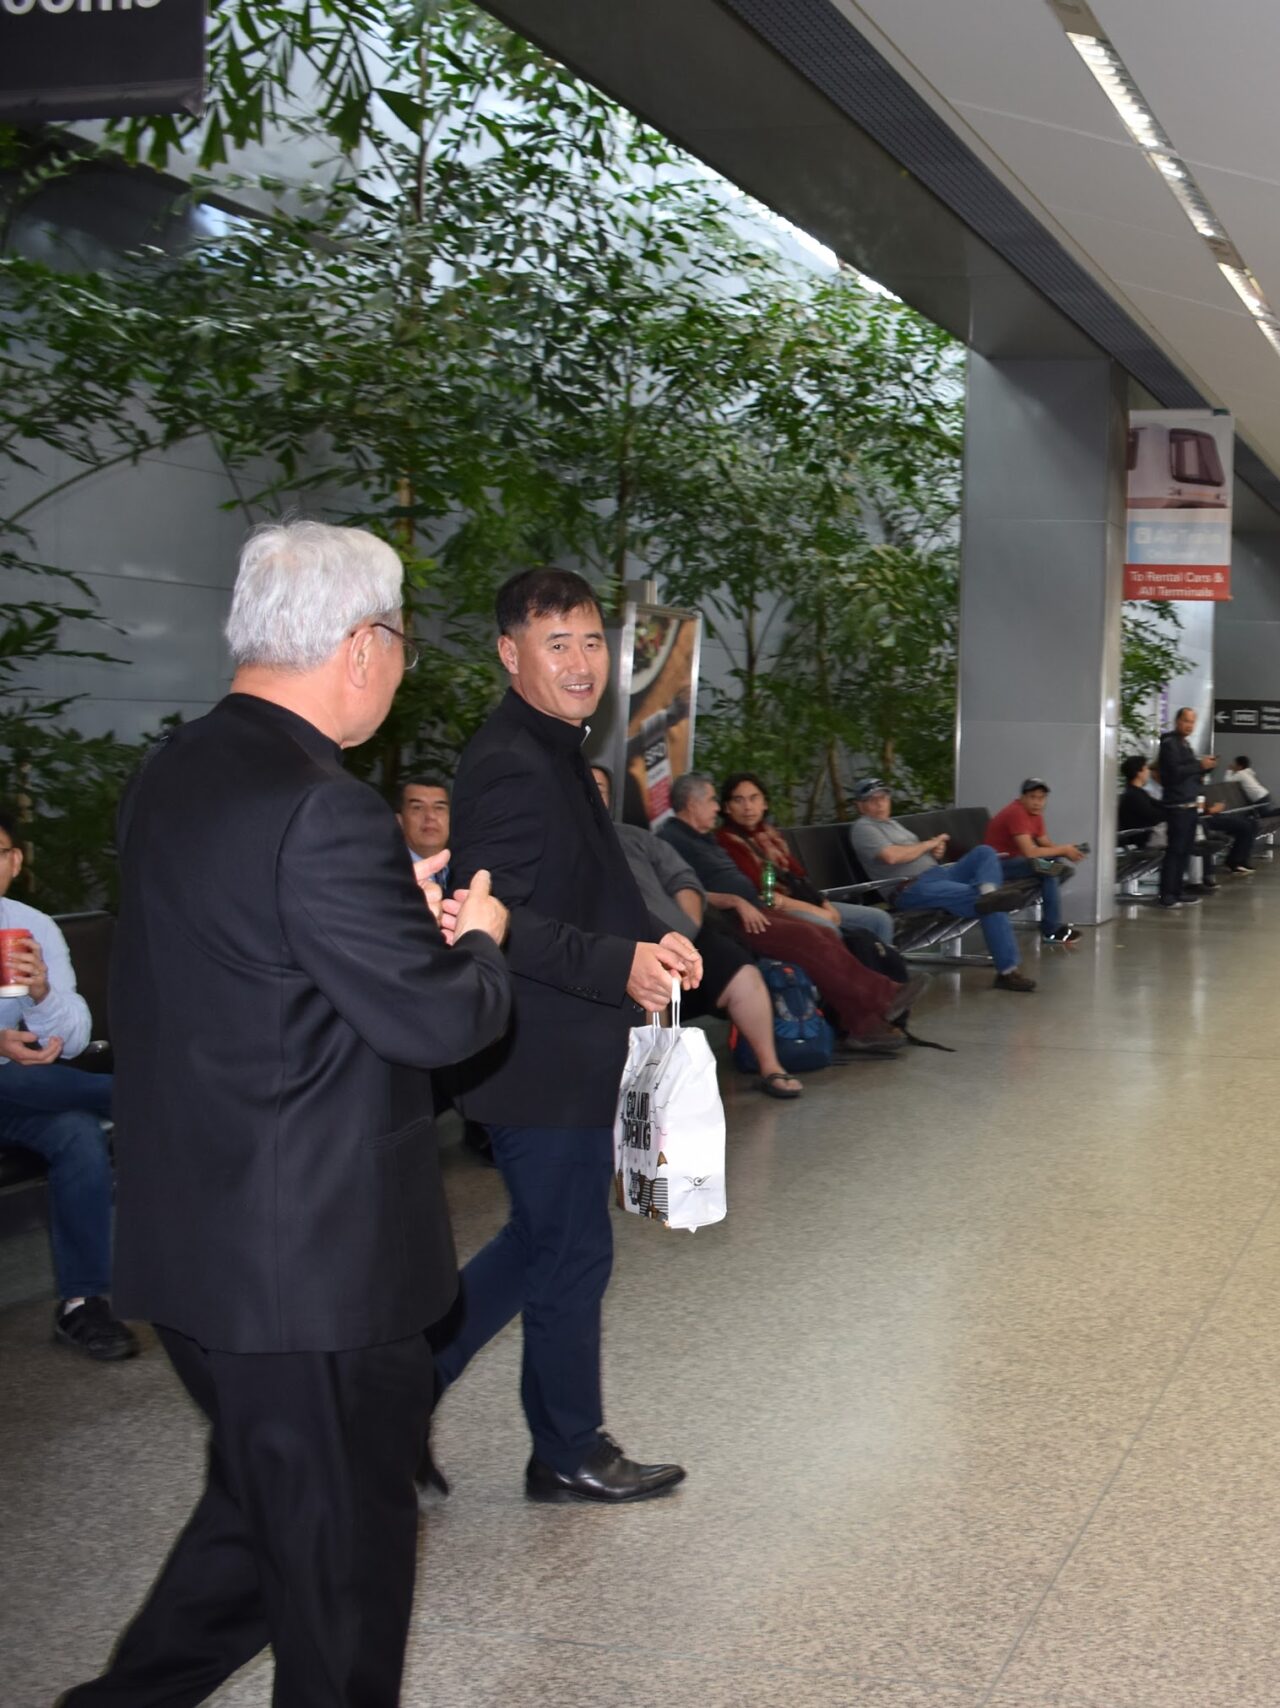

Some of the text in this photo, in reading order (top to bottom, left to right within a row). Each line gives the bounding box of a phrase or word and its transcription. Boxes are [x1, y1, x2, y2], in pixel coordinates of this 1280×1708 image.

[1129, 571, 1224, 583] To Rental Cars &
[1138, 586, 1214, 597] All Terminals
